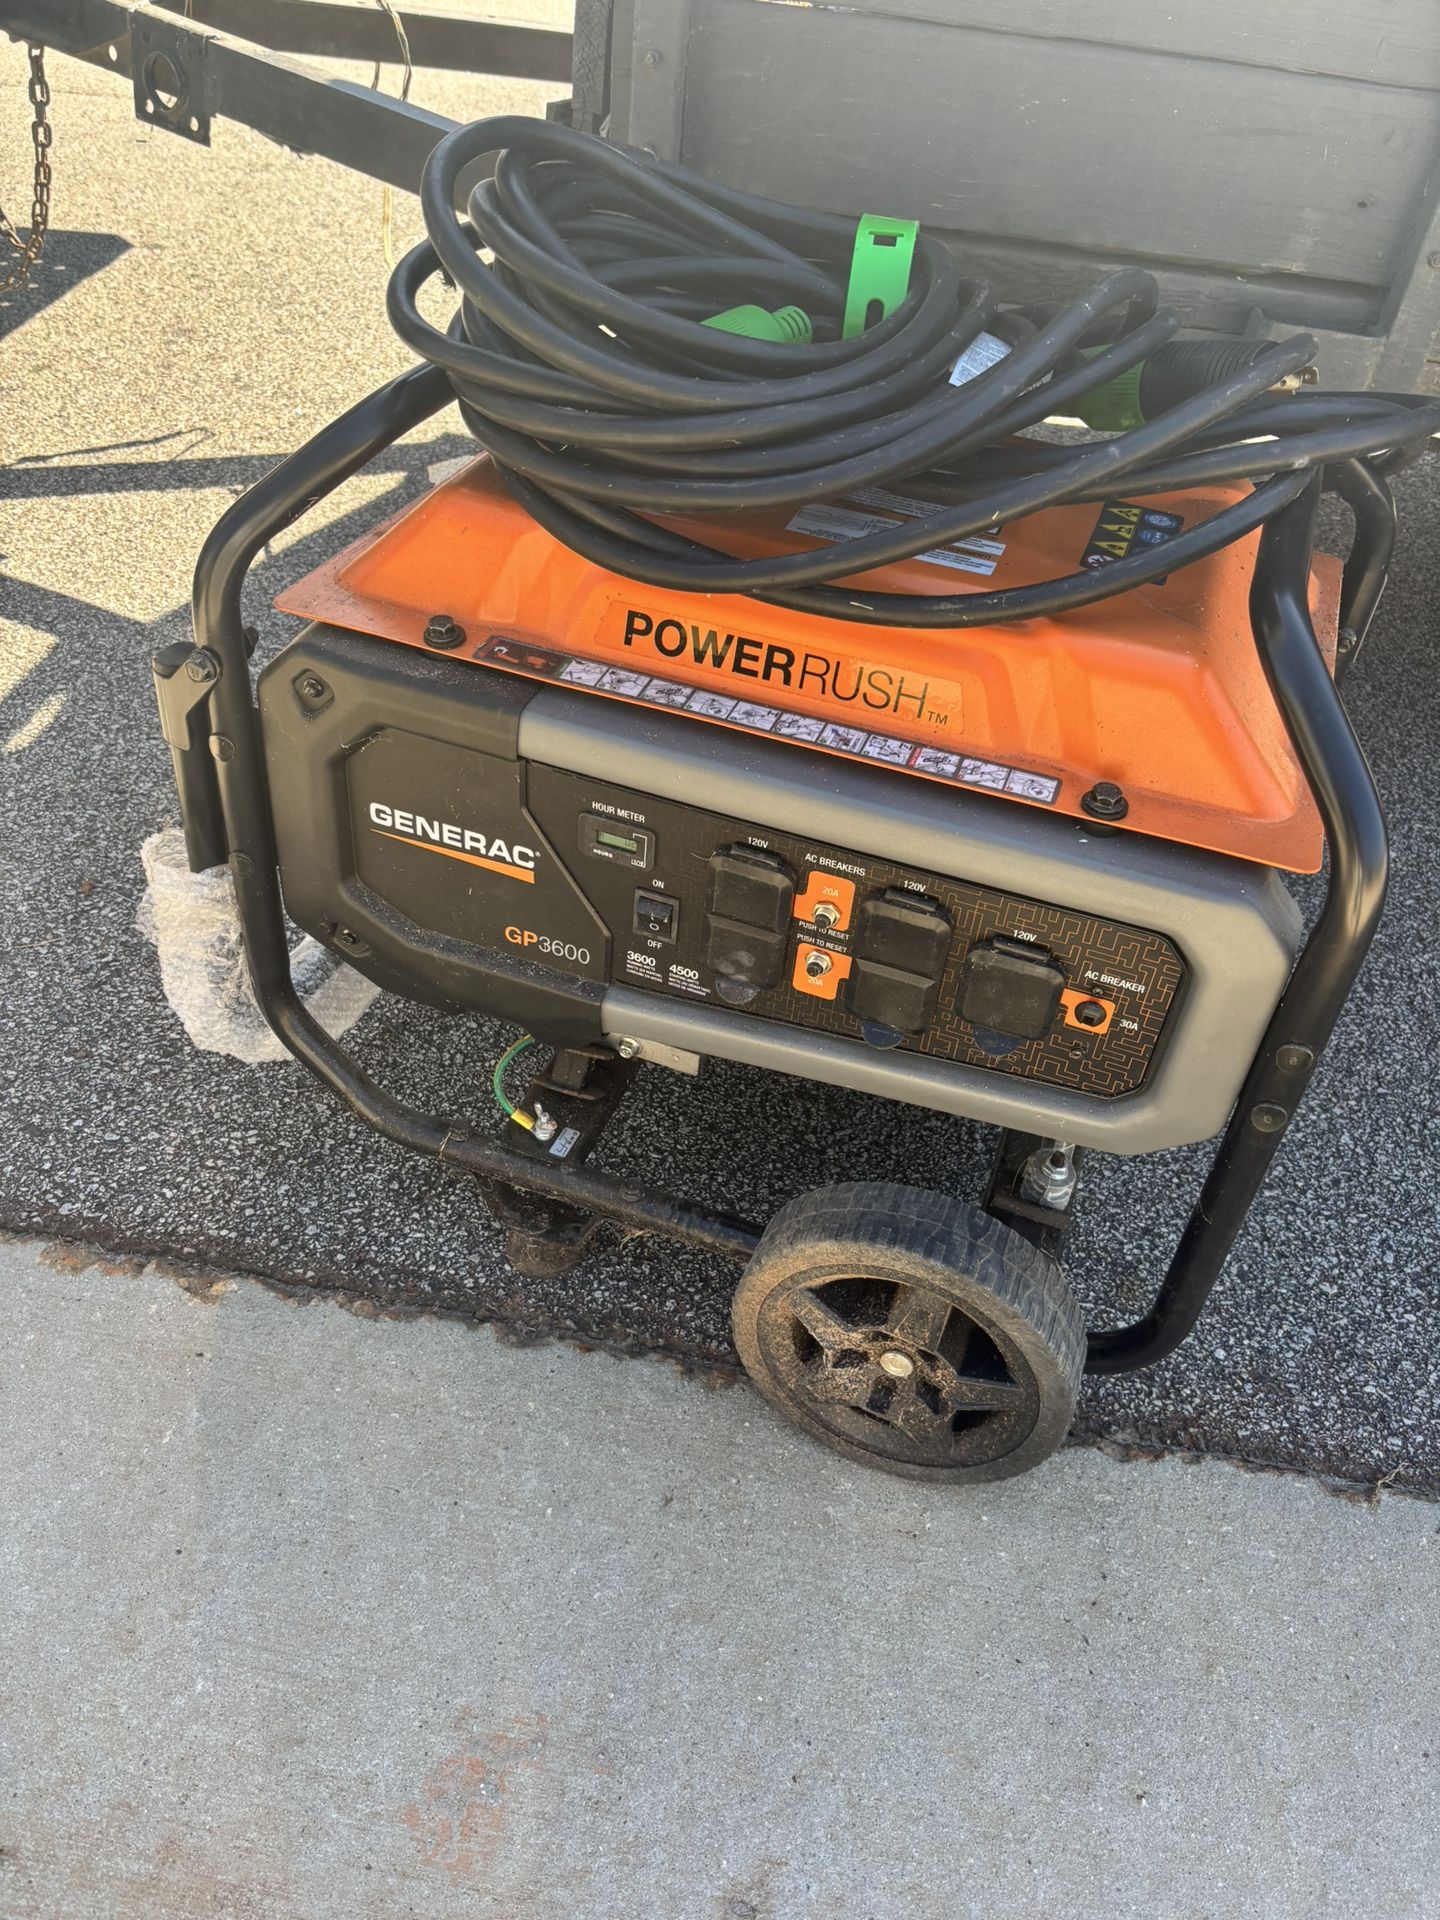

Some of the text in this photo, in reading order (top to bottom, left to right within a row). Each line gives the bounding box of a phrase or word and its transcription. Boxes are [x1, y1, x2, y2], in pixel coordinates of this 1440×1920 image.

[623, 609, 929, 719] POWERRUSH
[592, 801, 645, 823] HOUR METER
[369, 802, 535, 869] GENERAC
[747, 837, 768, 849] 120V
[805, 853, 866, 877] AC BREAKERS
[652, 878, 665, 889] ON
[822, 886, 839, 897] 20A
[903, 880, 926, 893] 120V
[798, 920, 817, 932] PUSH
[828, 928, 850, 941] RESET
[1012, 929, 1037, 943] 120V
[504, 926, 590, 965] GP3600
[647, 940, 663, 950] OFF
[796, 933, 848, 953] PUSH TO RESET
[626, 950, 656, 967] 3600
[669, 964, 699, 980] 4500
[807, 976, 823, 987] 20A
[1084, 970, 1145, 994] AC BREAKER
[1119, 1019, 1138, 1031] 30A
